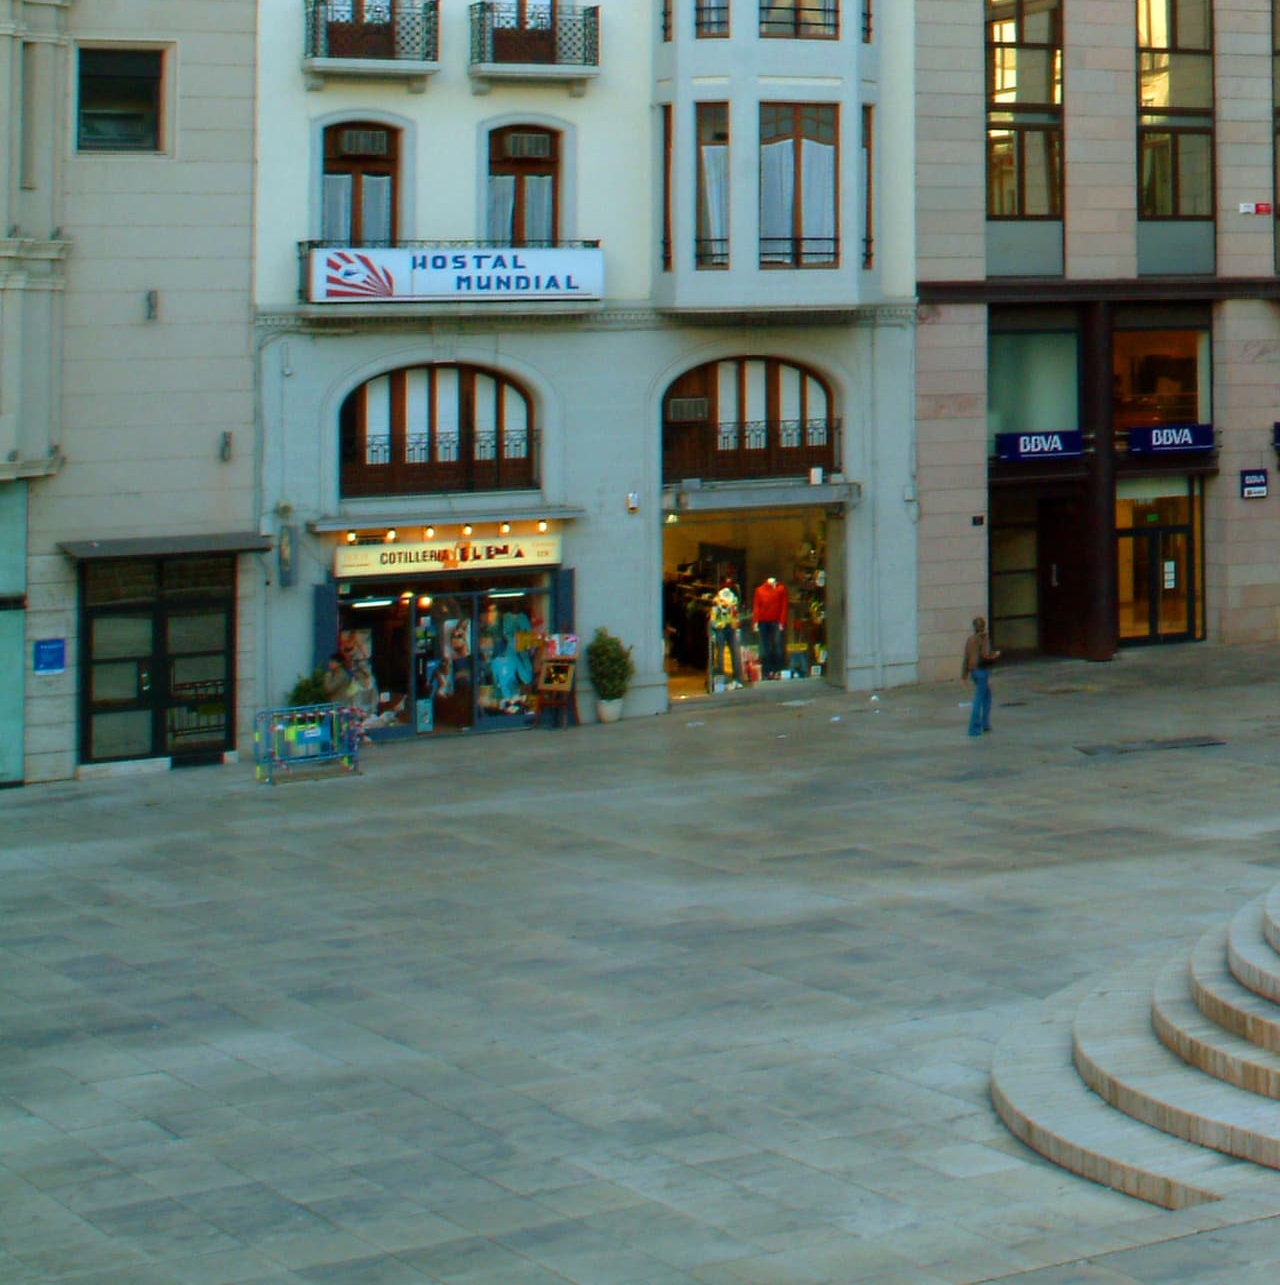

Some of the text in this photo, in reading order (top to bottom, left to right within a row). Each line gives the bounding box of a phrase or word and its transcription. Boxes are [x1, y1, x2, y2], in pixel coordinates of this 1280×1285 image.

[411, 255, 527, 270] HOSTAL
[456, 275, 579, 291] MUNDIAL
[1019, 435, 1063, 453] BBVA
[1152, 429, 1192, 446] BBVA
